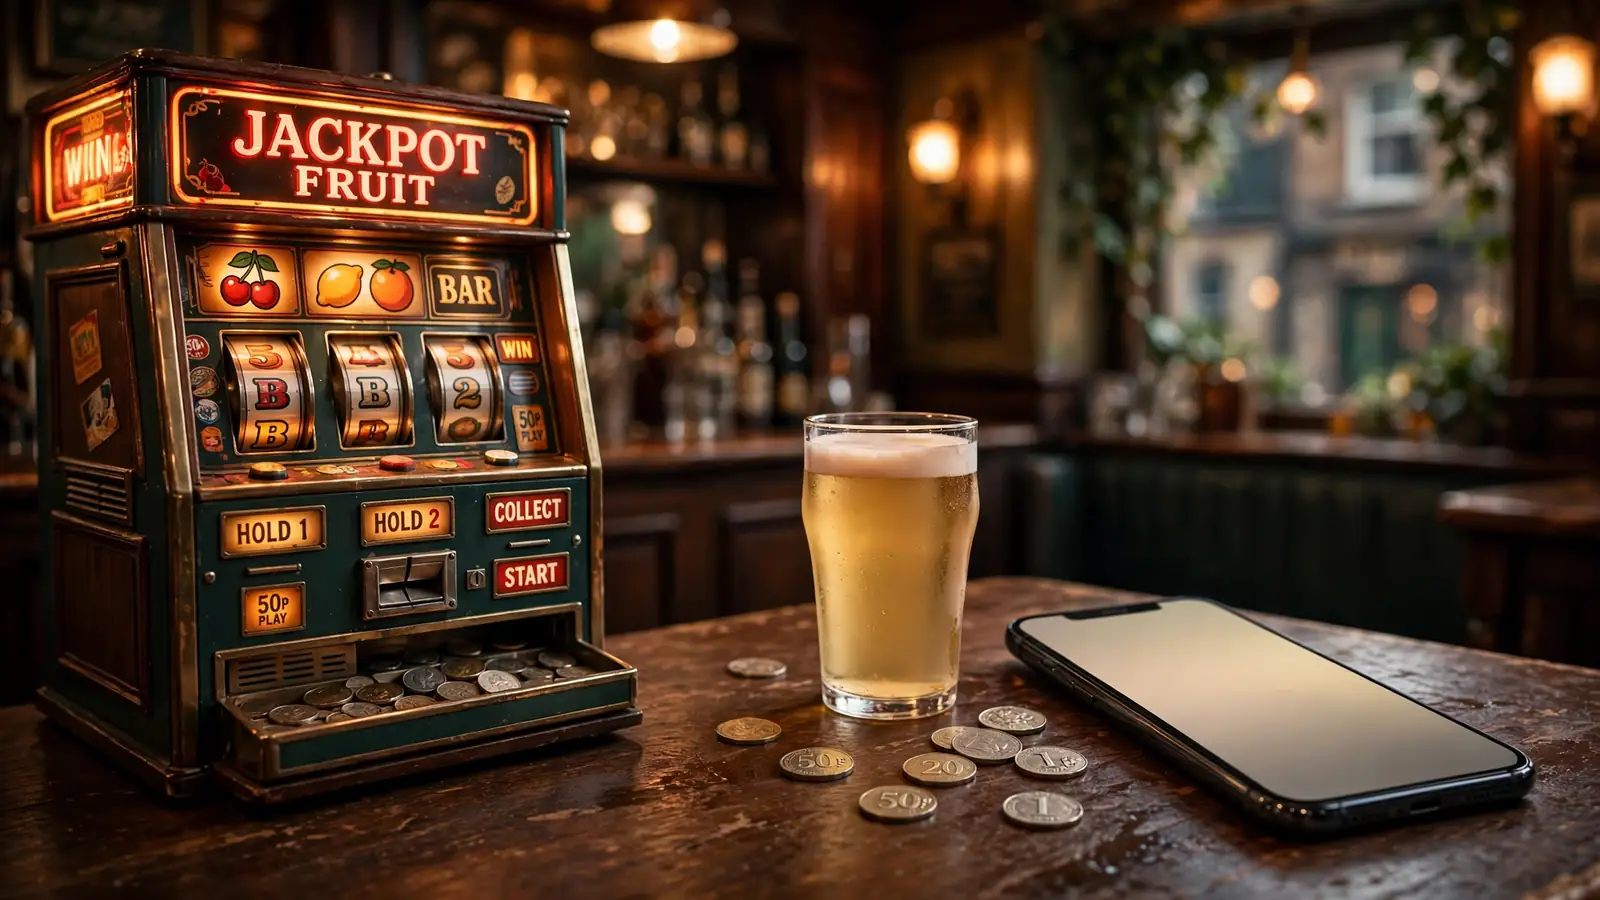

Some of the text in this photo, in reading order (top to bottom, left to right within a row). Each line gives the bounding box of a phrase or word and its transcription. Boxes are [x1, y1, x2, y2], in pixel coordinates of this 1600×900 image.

[234, 110, 486, 175] JACKPOT
[294, 165, 435, 205] FRUIT
[437, 274, 497, 305] BAR
[244, 344, 284, 370] 5
[501, 339, 533, 359] WIN
[252, 378, 291, 411] B
[356, 377, 391, 409] B
[453, 377, 482, 410] 2
[250, 420, 289, 450] B
[521, 430, 543, 442] PLAY
[374, 508, 440, 533] HOLD 2
[494, 498, 562, 523] COLLECT
[237, 518, 308, 545] HOLD 1
[504, 562, 558, 588] START
[258, 613, 287, 626] PLAY
[922, 759, 964, 776] 20
[1030, 796, 1056, 816] 1
